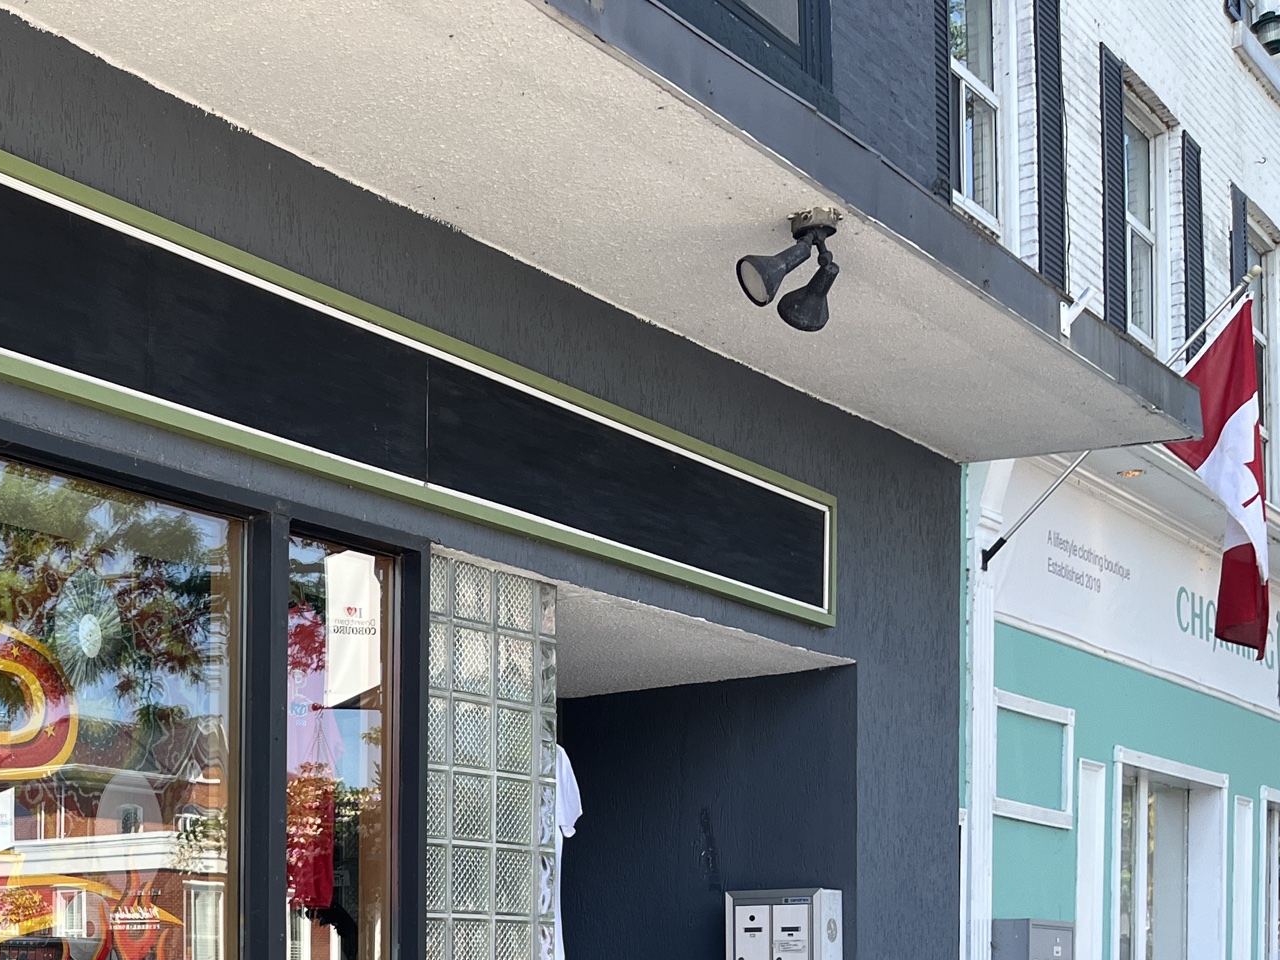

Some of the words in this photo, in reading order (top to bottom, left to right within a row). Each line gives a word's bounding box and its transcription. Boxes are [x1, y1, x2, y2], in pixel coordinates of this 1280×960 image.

[1047, 529, 1052, 546] A
[1053, 530, 1077, 558] lifestyle
[1078, 544, 1103, 572] clothing
[1104, 554, 1131, 581] boutique
[1048, 557, 1084, 586] Established
[1084, 573, 1101, 594] 2019
